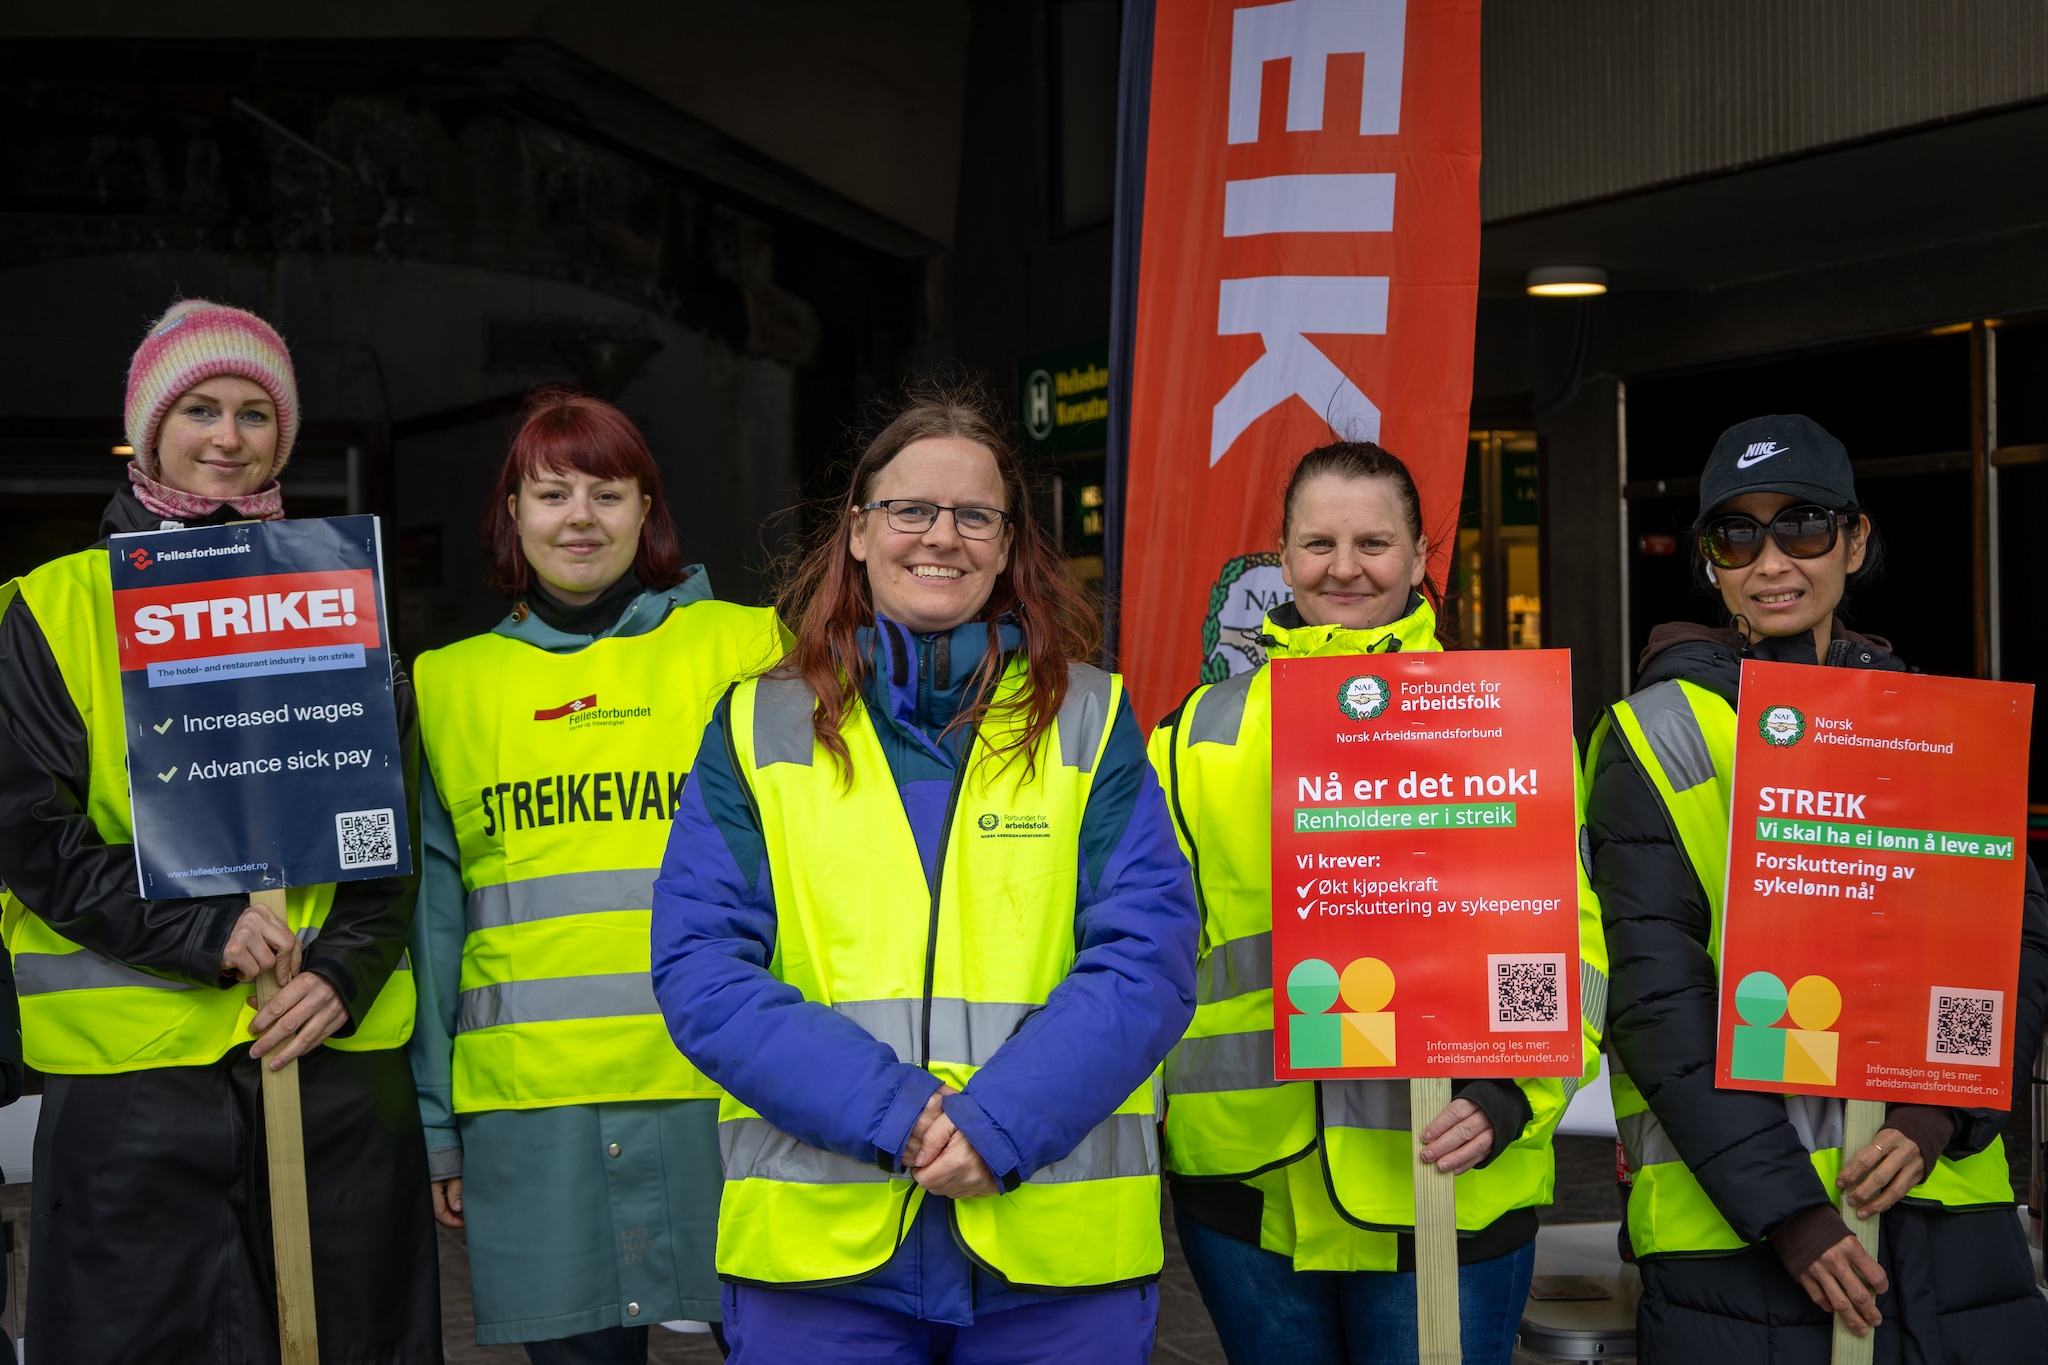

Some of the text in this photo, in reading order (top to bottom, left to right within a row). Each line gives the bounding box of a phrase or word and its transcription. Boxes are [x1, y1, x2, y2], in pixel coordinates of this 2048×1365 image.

[1745, 442, 1777, 458] NIKE
[156, 543, 251, 562] Fellesforbundet
[133, 588, 357, 645] STRIKE!
[157, 651, 355, 678] The hotel- and restaurant industry is on strike
[1354, 683, 1374, 691] NAF
[1401, 680, 1501, 695] Forbundet for
[1400, 694, 1502, 712] arbeidsfolk
[183, 701, 364, 733] Increased wages
[569, 706, 652, 725] Fellesforbundet
[1774, 713, 1792, 721] NAF
[1814, 715, 1854, 731] Norsk
[1335, 727, 1503, 744] Norsk Arbeidsmandsforbund
[1813, 731, 1955, 755] Arbeidsmandsforbund
[188, 748, 372, 782] Advance sick pay
[1297, 768, 1539, 802] Nå er det nok!
[1758, 786, 1868, 820] STREIK
[1296, 806, 1513, 830] Renholdere er i streik
[1759, 820, 2013, 858] Vi skal ha ei lønn å leve av!
[166, 862, 269, 879] www.fellesforbundet.no
[1295, 852, 1382, 870] Vi krever:
[1755, 851, 1916, 883] Forskuttering av
[1317, 876, 1439, 898] Økt kjøpekraft
[1753, 876, 1875, 901] sykelønn nå!
[1318, 896, 1562, 918] Forskuttering av sykepenger
[1426, 1039, 1551, 1053] Informasjon og les mer:
[1426, 1051, 1570, 1064] arbeidsmandsforbundet.no
[1866, 1063, 1982, 1081] Informasjon og les mer:
[1866, 1078, 1999, 1095] arbeidsmandsforbundet.no
